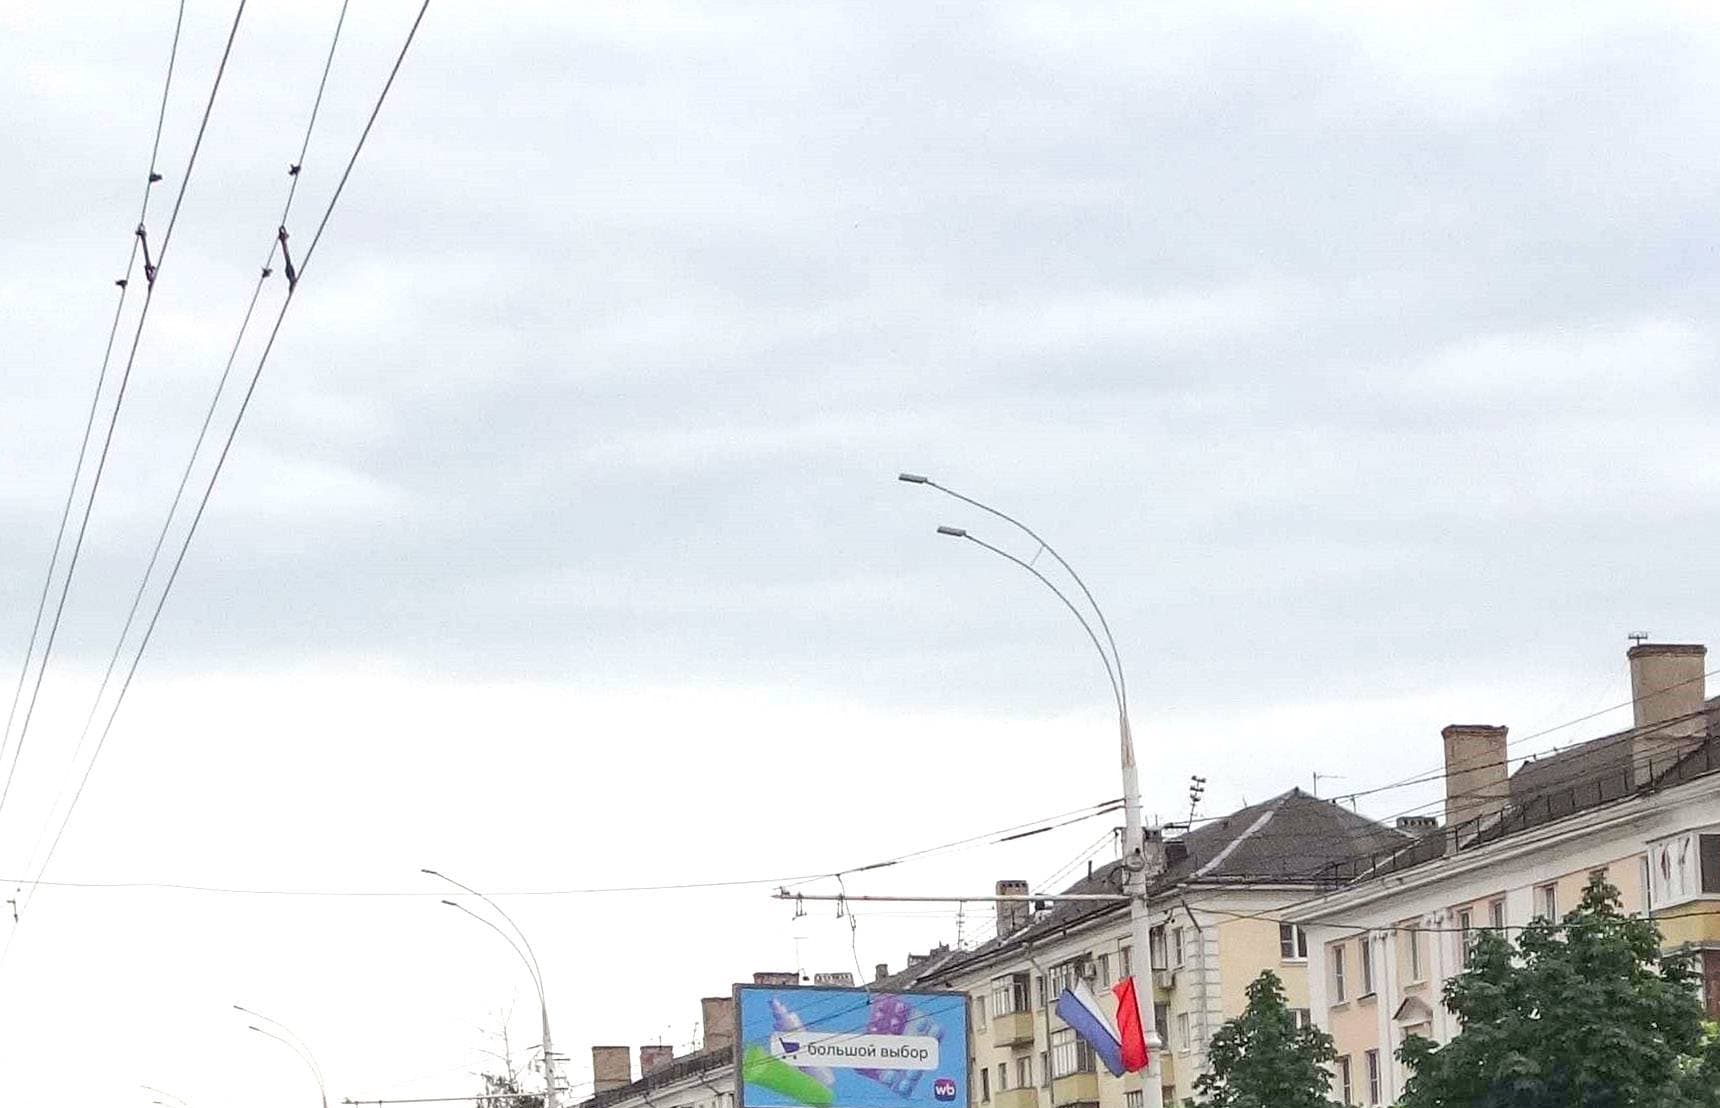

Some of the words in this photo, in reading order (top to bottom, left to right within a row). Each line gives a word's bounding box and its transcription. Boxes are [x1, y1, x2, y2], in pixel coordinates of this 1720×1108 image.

[806, 1041, 877, 1057] большой
[880, 1043, 929, 1061] выбор
[935, 1082, 955, 1097] wb
